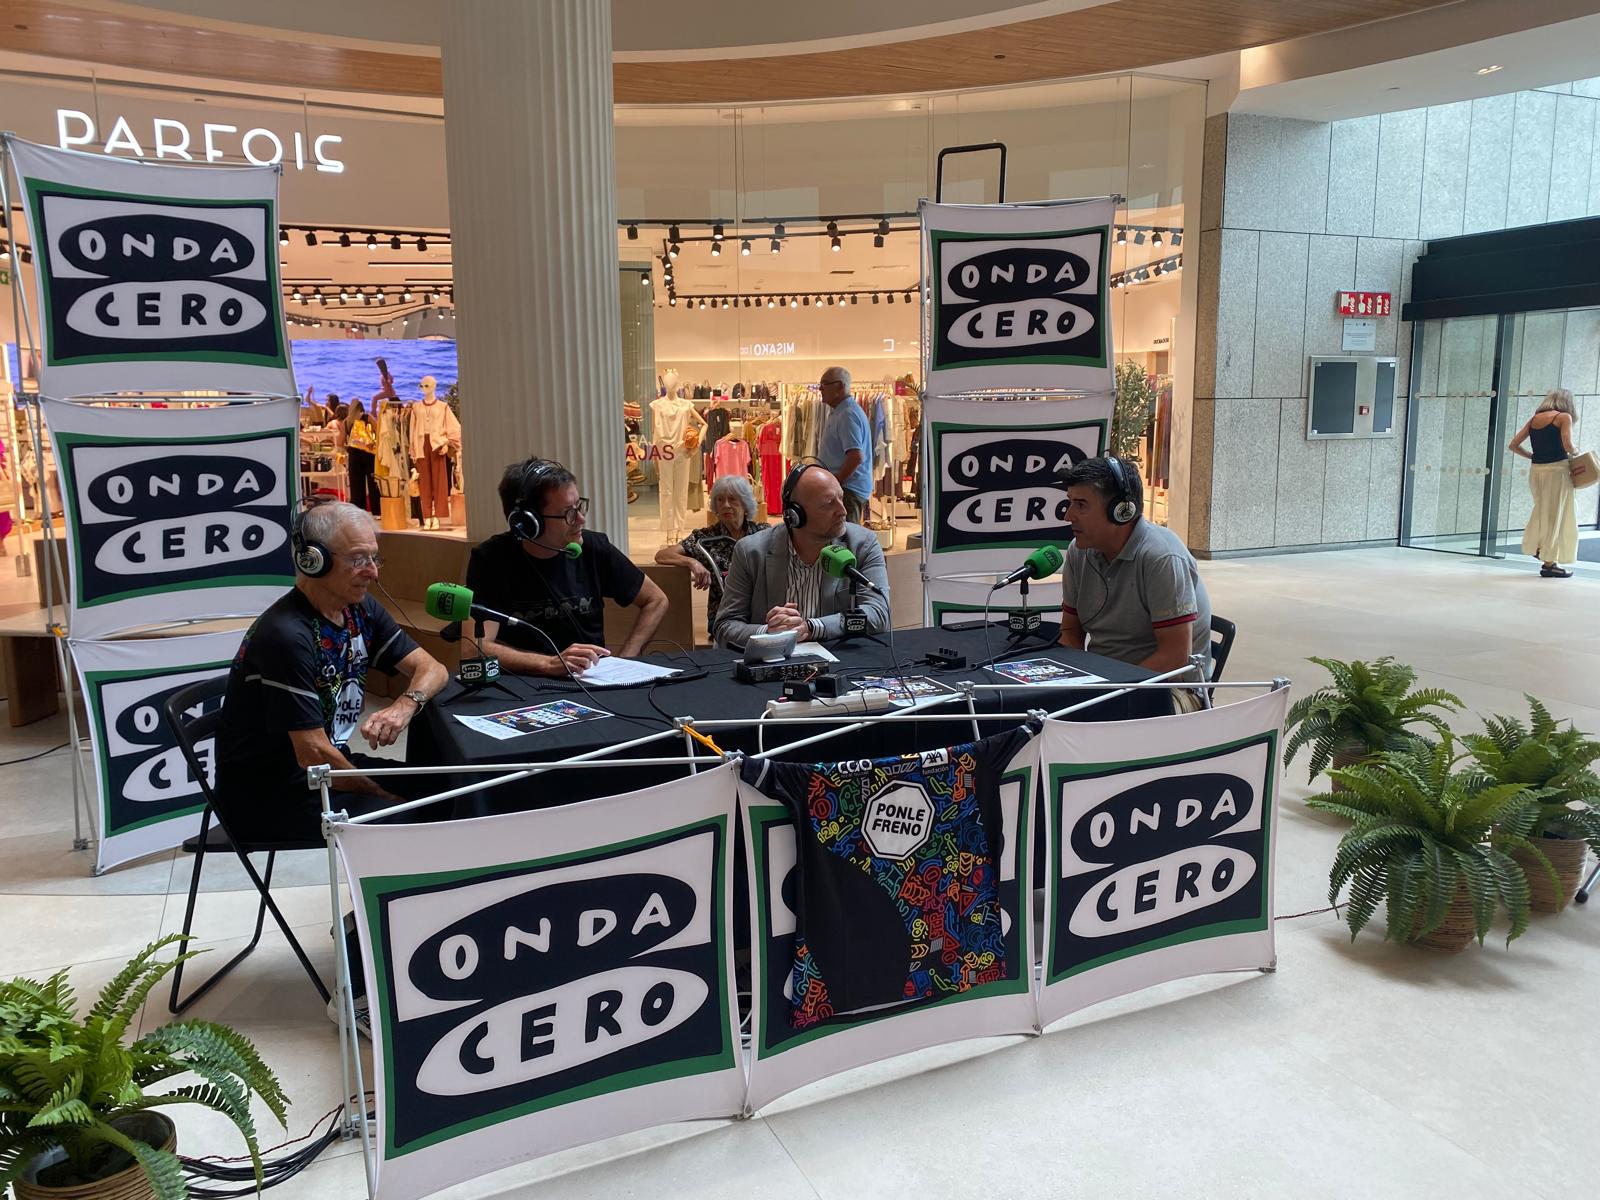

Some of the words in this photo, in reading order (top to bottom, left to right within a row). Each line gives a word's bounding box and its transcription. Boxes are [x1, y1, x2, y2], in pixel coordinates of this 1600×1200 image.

[56, 109, 345, 174] PARFOIS
[77, 228, 239, 264] ONDA
[961, 261, 1076, 289] ONDA
[95, 291, 243, 327] CERO
[967, 309, 1076, 339] CERO
[625, 444, 675, 461] AJAS
[961, 452, 1074, 478] ONDA
[106, 468, 260, 504] ONDA
[122, 523, 265, 563] CERO
[149, 747, 209, 790] CE
[871, 818, 922, 837] FRENO
[876, 803, 926, 822] PONLE
[1089, 788, 1237, 848] ONDA
[1096, 857, 1236, 922] CERO
[438, 892, 671, 980] ONDA
[459, 981, 675, 1075] CERO
